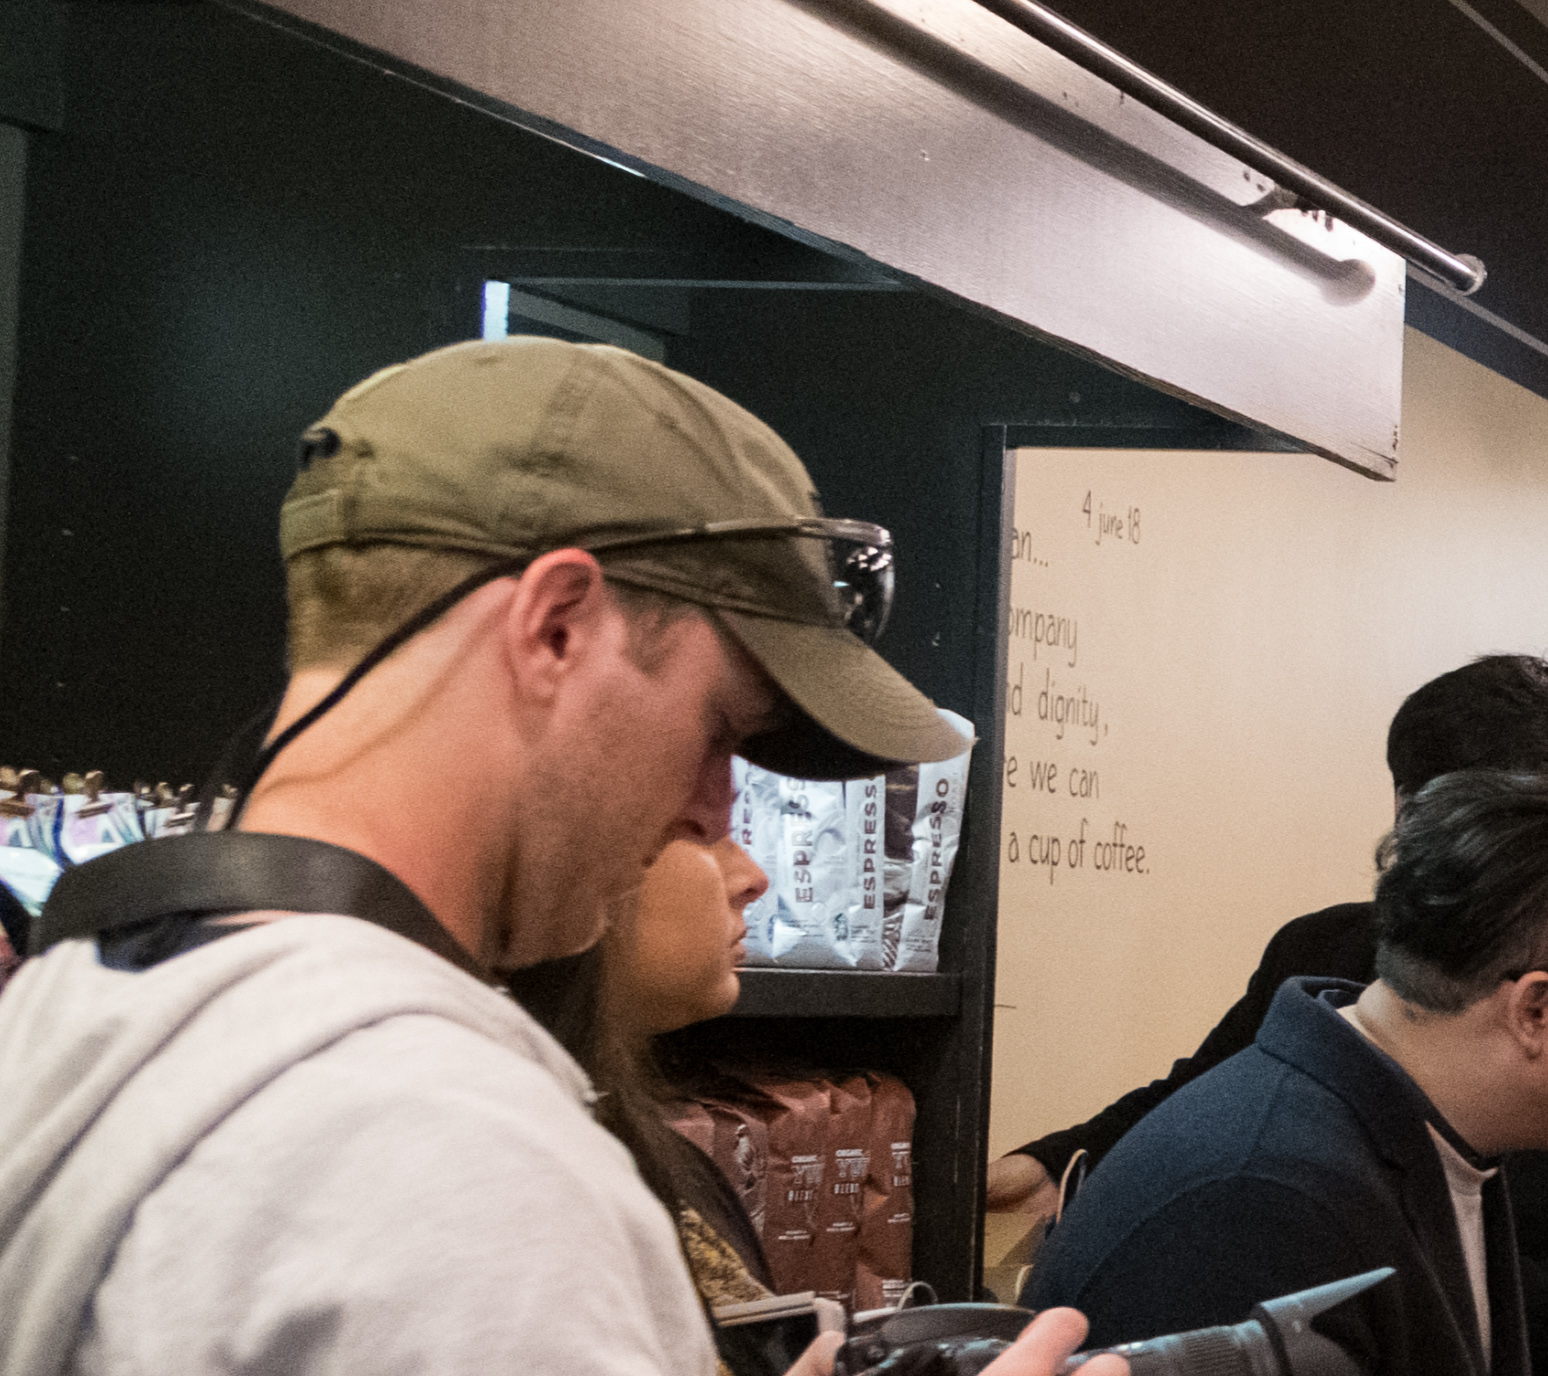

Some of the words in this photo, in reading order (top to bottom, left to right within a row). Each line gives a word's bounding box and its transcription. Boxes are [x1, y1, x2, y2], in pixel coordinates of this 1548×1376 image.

[1082, 489, 1092, 528] 4
[1095, 503, 1123, 545] june
[1038, 667, 1108, 745] dignity,
[1030, 761, 1057, 794] we
[1069, 765, 1100, 799] can
[787, 779, 813, 903] ESPRESS
[863, 778, 878, 910] ESPRESS
[923, 778, 950, 922] ESPRESSO
[1008, 831, 1019, 863] a
[1029, 834, 1061, 885] cup
[1068, 818, 1088, 869] of
[1094, 821, 1150, 874] coffee.
